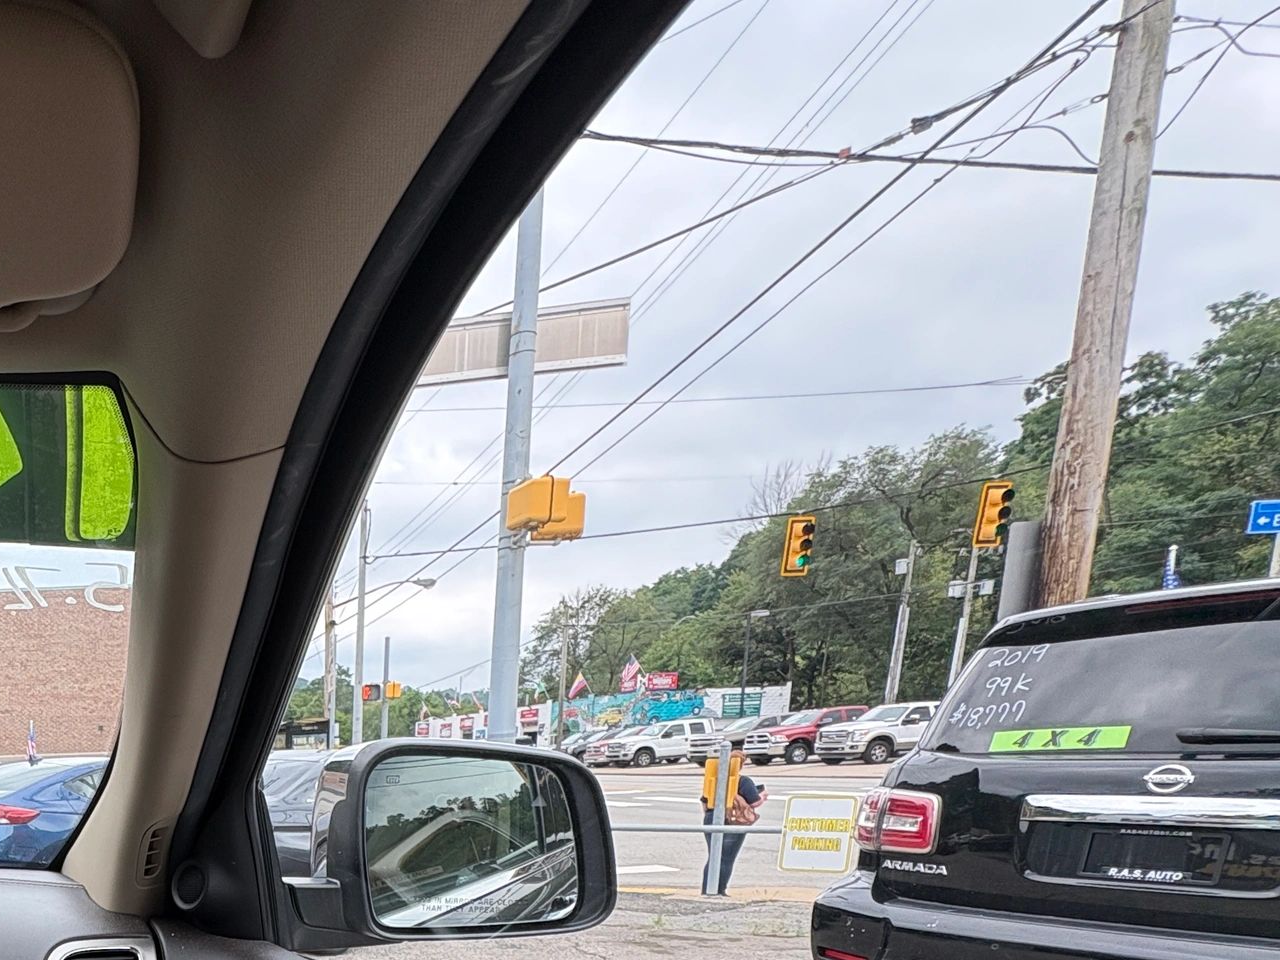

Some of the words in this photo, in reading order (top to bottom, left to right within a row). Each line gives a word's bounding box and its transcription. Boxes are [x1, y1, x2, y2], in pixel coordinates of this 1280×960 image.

[988, 643, 1050, 668] 2019
[788, 818, 851, 833] CUSTOMER
[791, 835, 841, 851] PARKING
[881, 859, 948, 876] ARMADA
[1108, 867, 1144, 879] R.A.S.
[1146, 870, 1184, 882] AUTO
